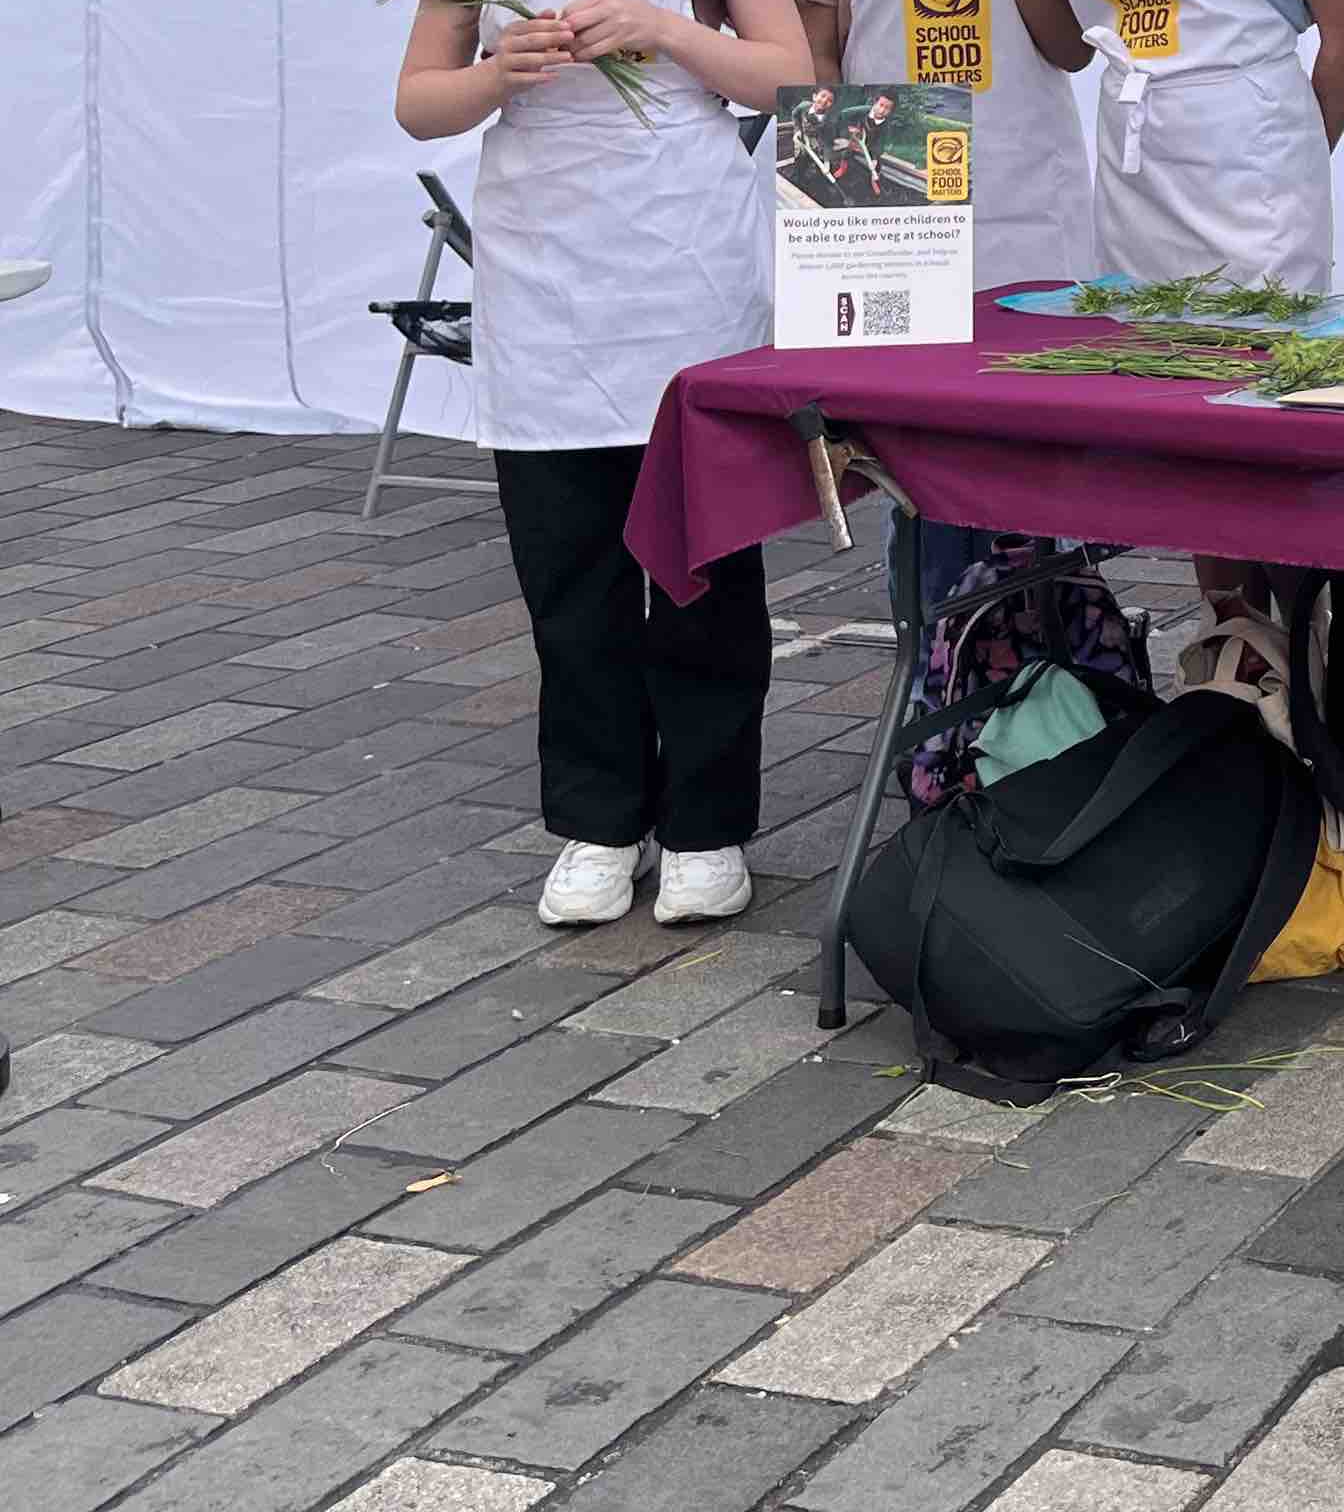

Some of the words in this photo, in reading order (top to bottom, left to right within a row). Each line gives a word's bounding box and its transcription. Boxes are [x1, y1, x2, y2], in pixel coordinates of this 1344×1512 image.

[1120, 8, 1169, 37] FOOD
[915, 25, 981, 43] SCHOOL
[1124, 33, 1169, 48] ATTERS
[916, 43, 982, 71] FOOD
[917, 70, 982, 85] MATTERS
[931, 168, 962, 177] SCHOOL
[931, 177, 963, 188] FOOD
[783, 217, 820, 228] Would
[823, 219, 844, 229] you
[847, 216, 868, 227] like
[871, 216, 901, 225] more
[903, 214, 951, 225] children
[953, 215, 966, 223] to
[788, 233, 803, 243] be
[805, 232, 830, 242] able
[833, 233, 845, 242] to
[848, 232, 877, 244] grow
[879, 231, 901, 243] veg
[903, 231, 914, 240] at
[917, 228, 961, 240] school?
[840, 296, 849, 332] SCAN
